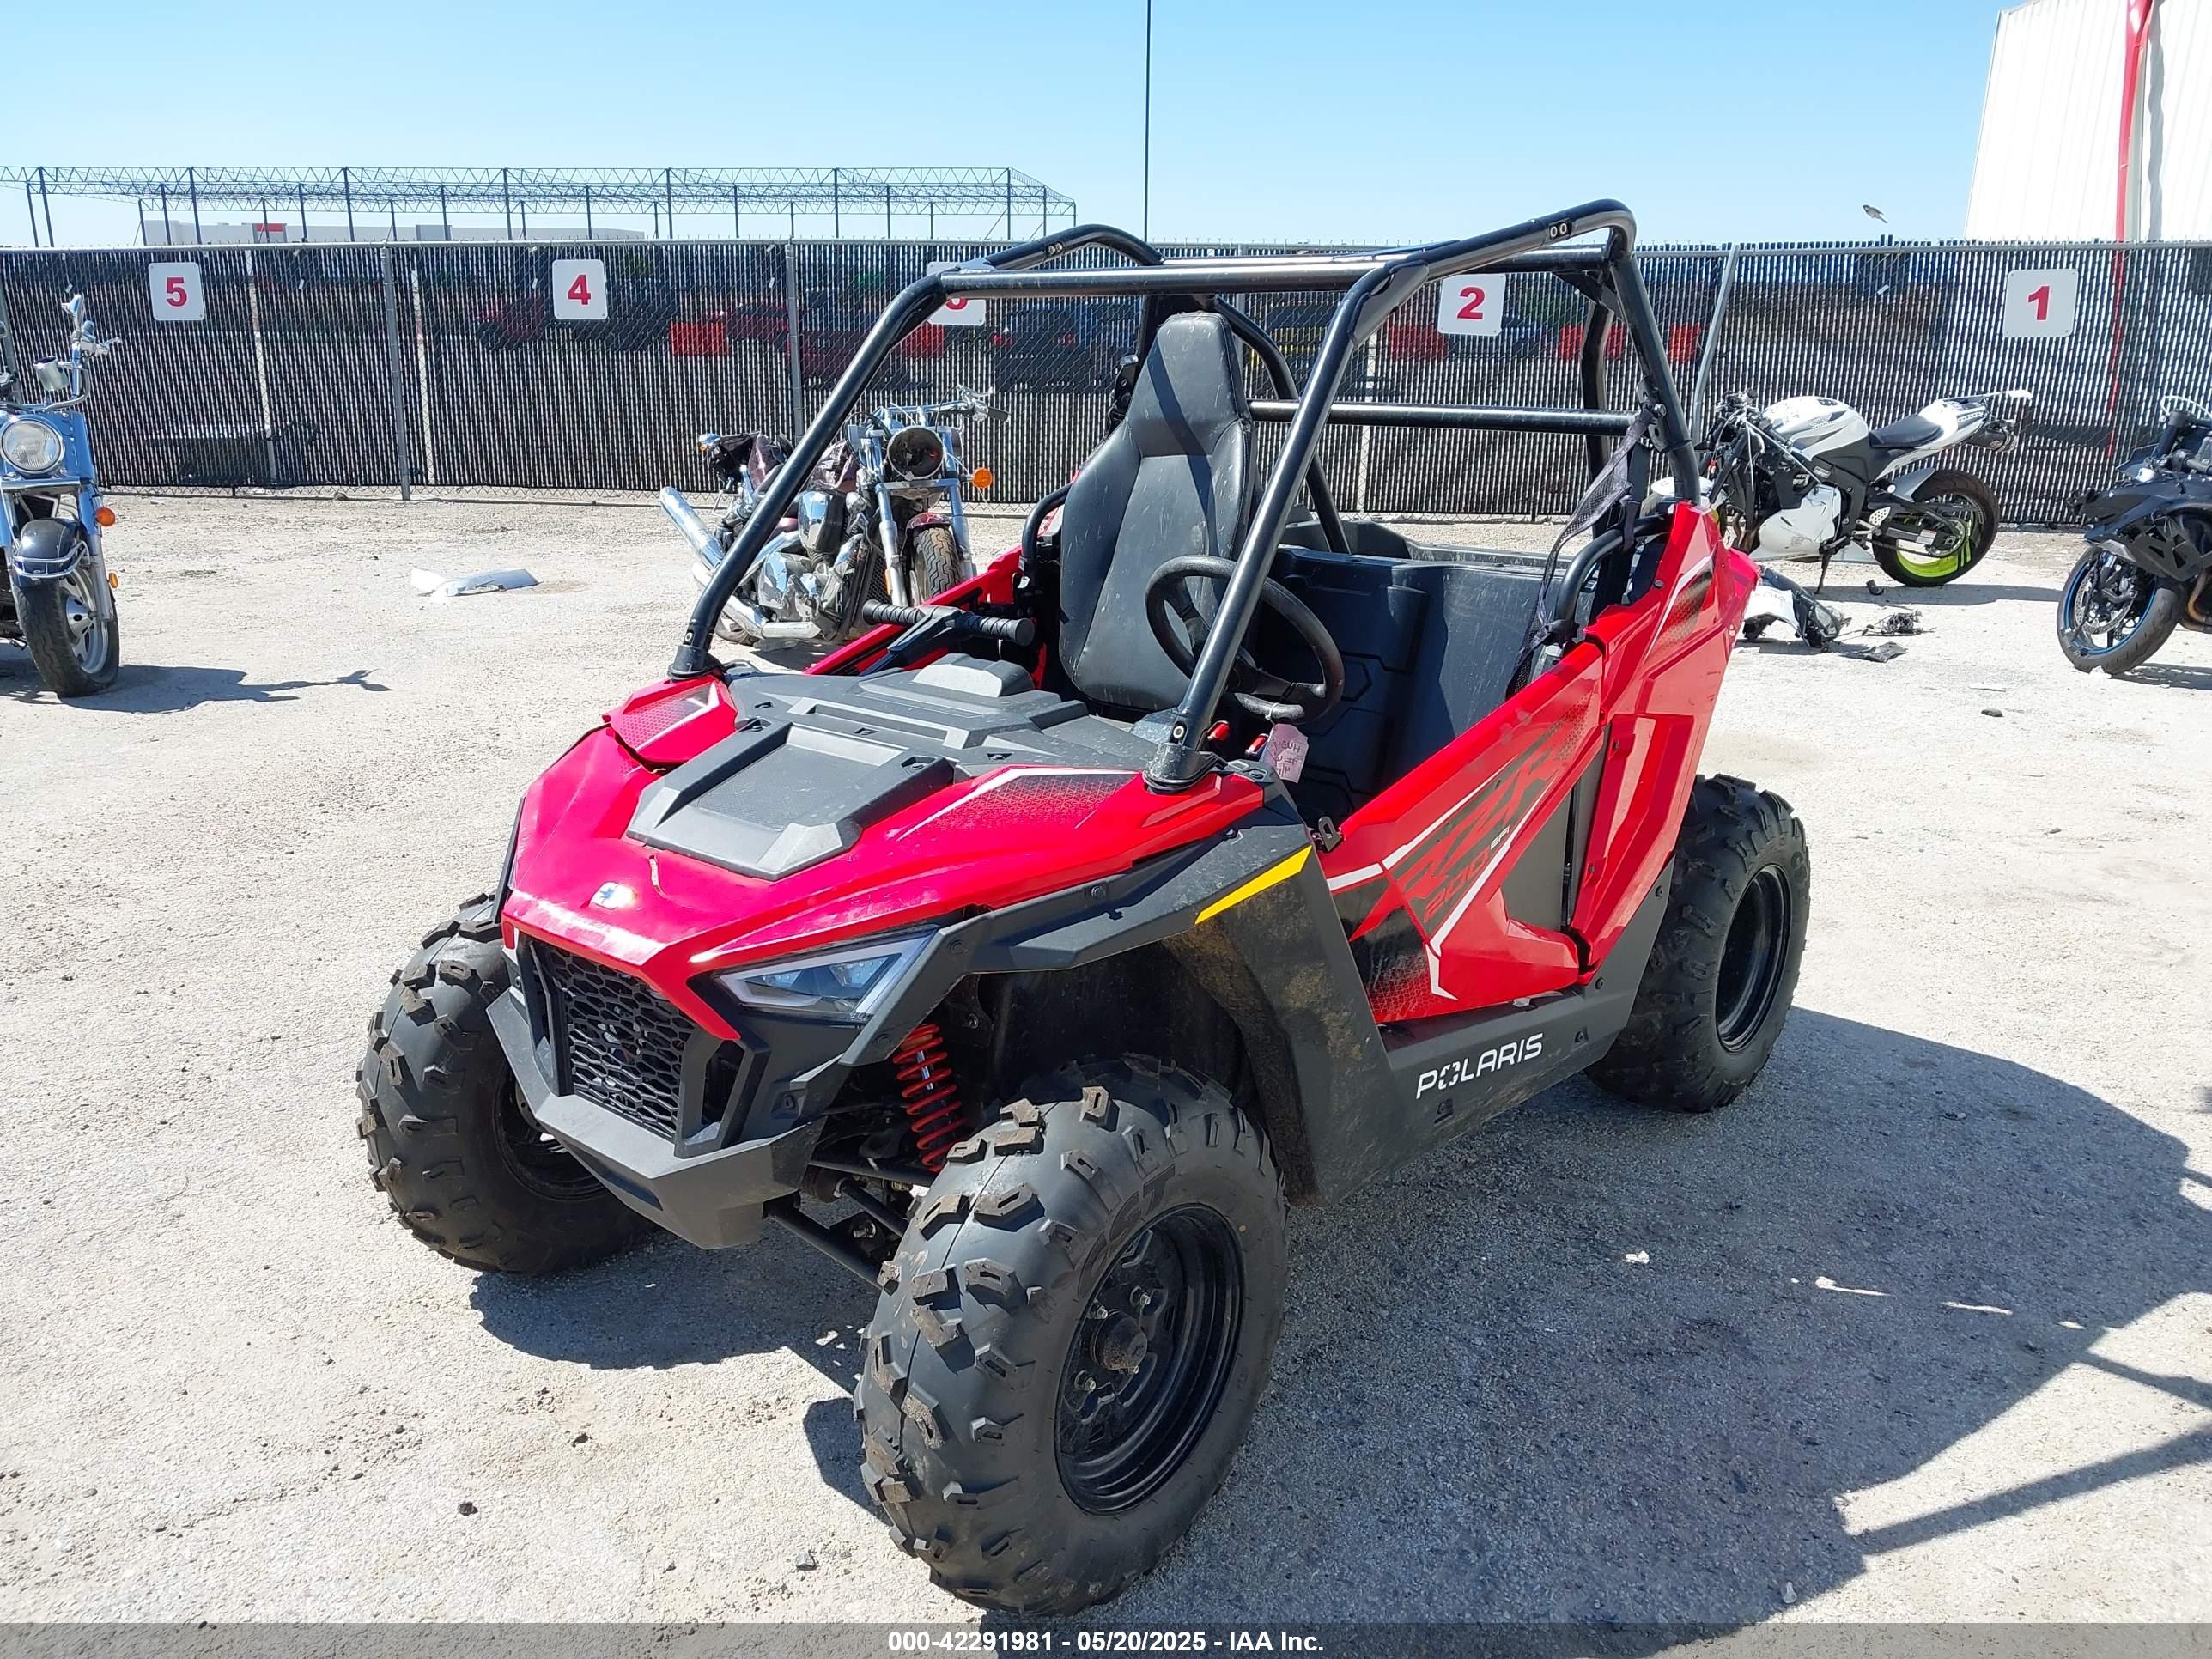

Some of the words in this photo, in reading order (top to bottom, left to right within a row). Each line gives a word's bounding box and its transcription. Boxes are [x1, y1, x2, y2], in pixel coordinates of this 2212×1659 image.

[167, 277, 187, 307] 5
[568, 275, 591, 305] 4
[1458, 287, 1485, 320] 2
[2028, 286, 2049, 320] 1
[1423, 846, 1489, 923] 200
[1490, 825, 1510, 850] EFI
[1416, 1033, 1544, 1100] POLARIS
